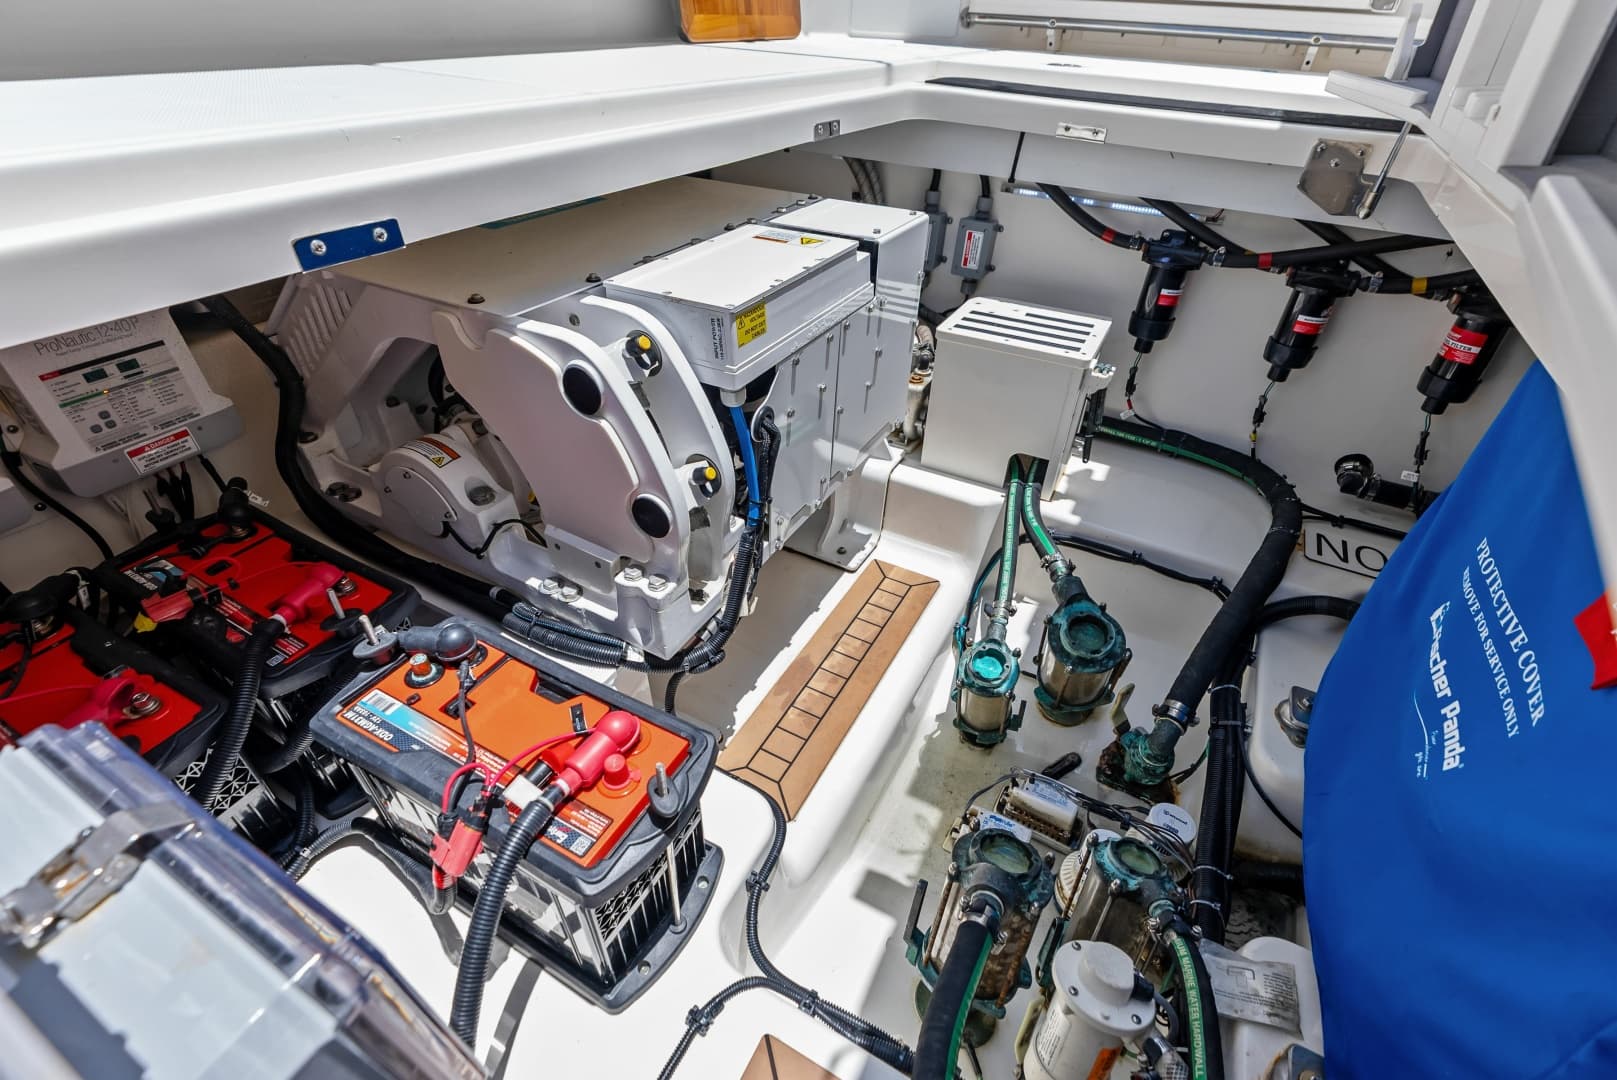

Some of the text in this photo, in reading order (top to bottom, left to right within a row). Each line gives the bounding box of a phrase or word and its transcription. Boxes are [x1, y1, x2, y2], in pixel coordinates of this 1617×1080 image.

[34, 327, 96, 357] ProNautic
[1450, 341, 1472, 351] FILTER
[150, 436, 175, 449] DANGER
[1317, 533, 1388, 571] NO
[1476, 537, 1546, 728] PROTECTIVE COVER
[1462, 566, 1521, 739] REMOVE FOR SERVICE ONLY
[1441, 700, 1466, 772] Panda
[1182, 956, 1194, 987] MARINE
[1189, 989, 1200, 1019] WATER
[1191, 1020, 1205, 1079] HARDWALL
